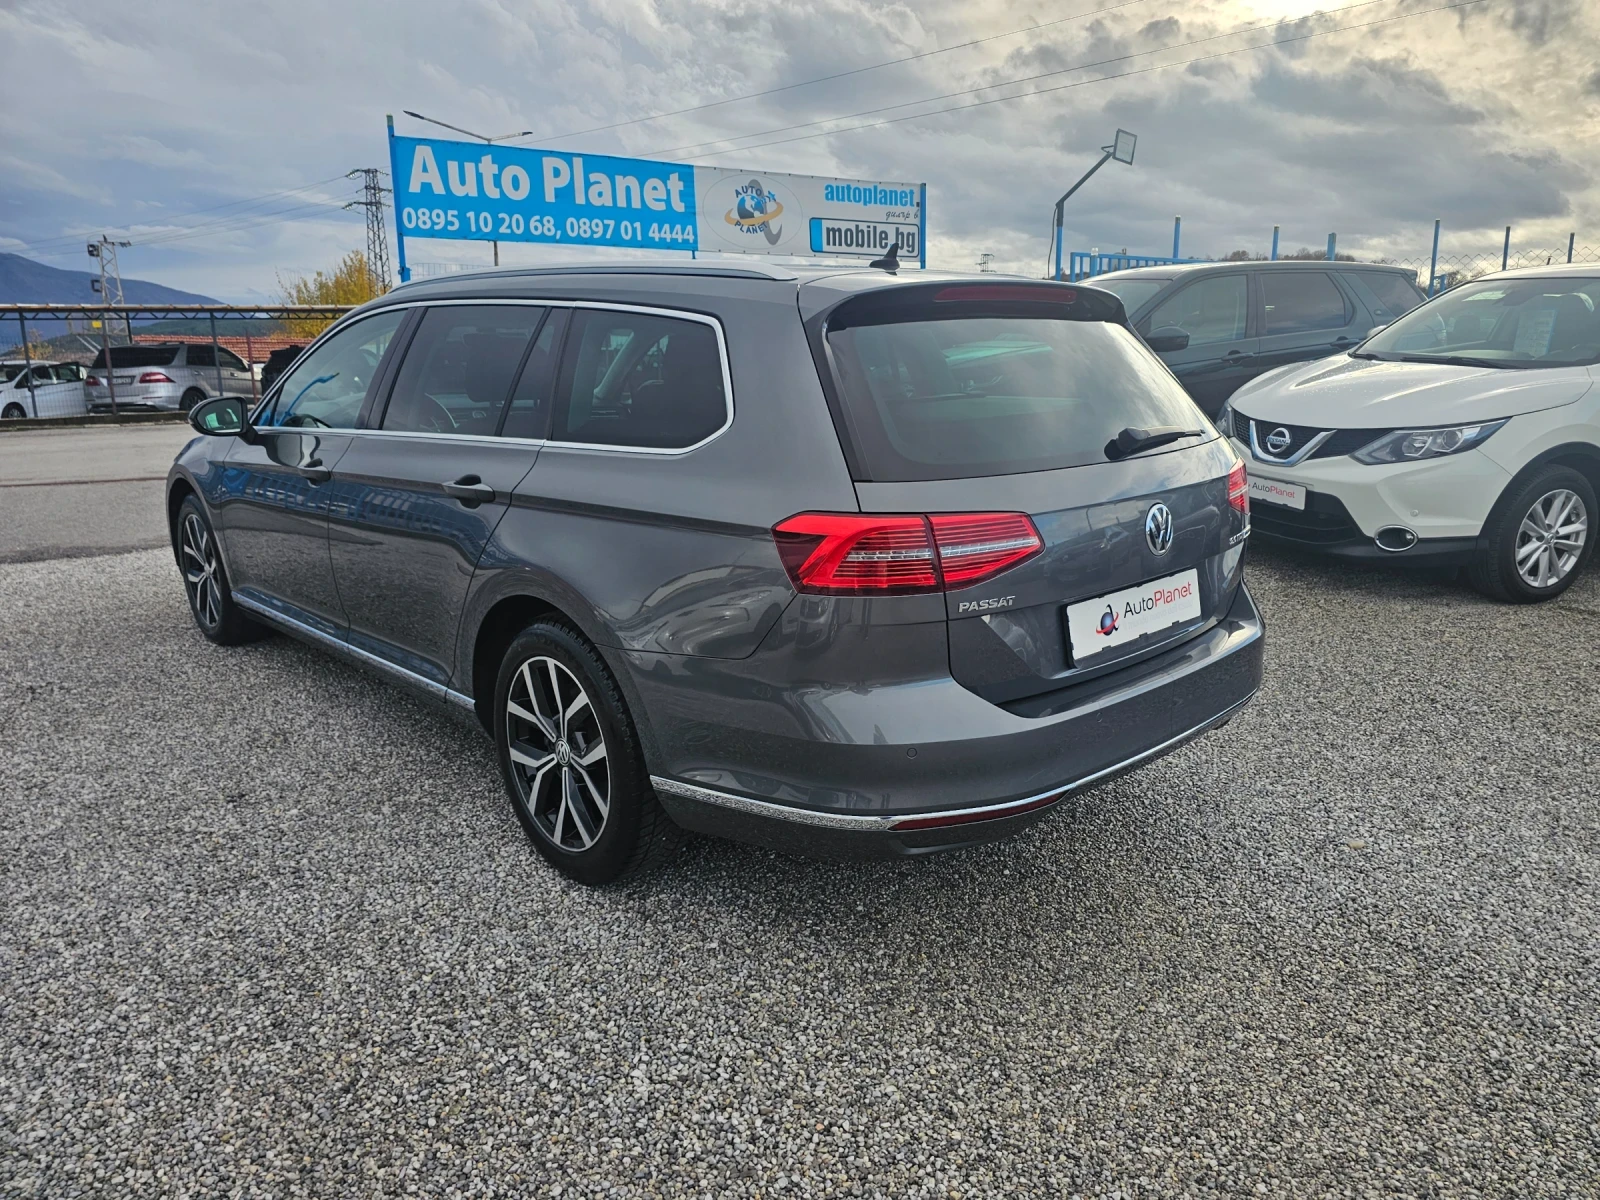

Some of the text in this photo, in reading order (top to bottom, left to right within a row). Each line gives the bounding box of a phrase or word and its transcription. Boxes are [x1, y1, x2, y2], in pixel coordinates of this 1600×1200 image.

[408, 144, 686, 213] Auto Planet
[734, 185, 763, 199] AUTO
[402, 207, 695, 243] 0895 10 20 68, 0897 01 4444
[734, 219, 768, 235] PLANET
[1252, 482, 1295, 499] AutoPlanet
[958, 595, 1016, 613] PASSAT
[1123, 581, 1192, 619] AutoPlanet
